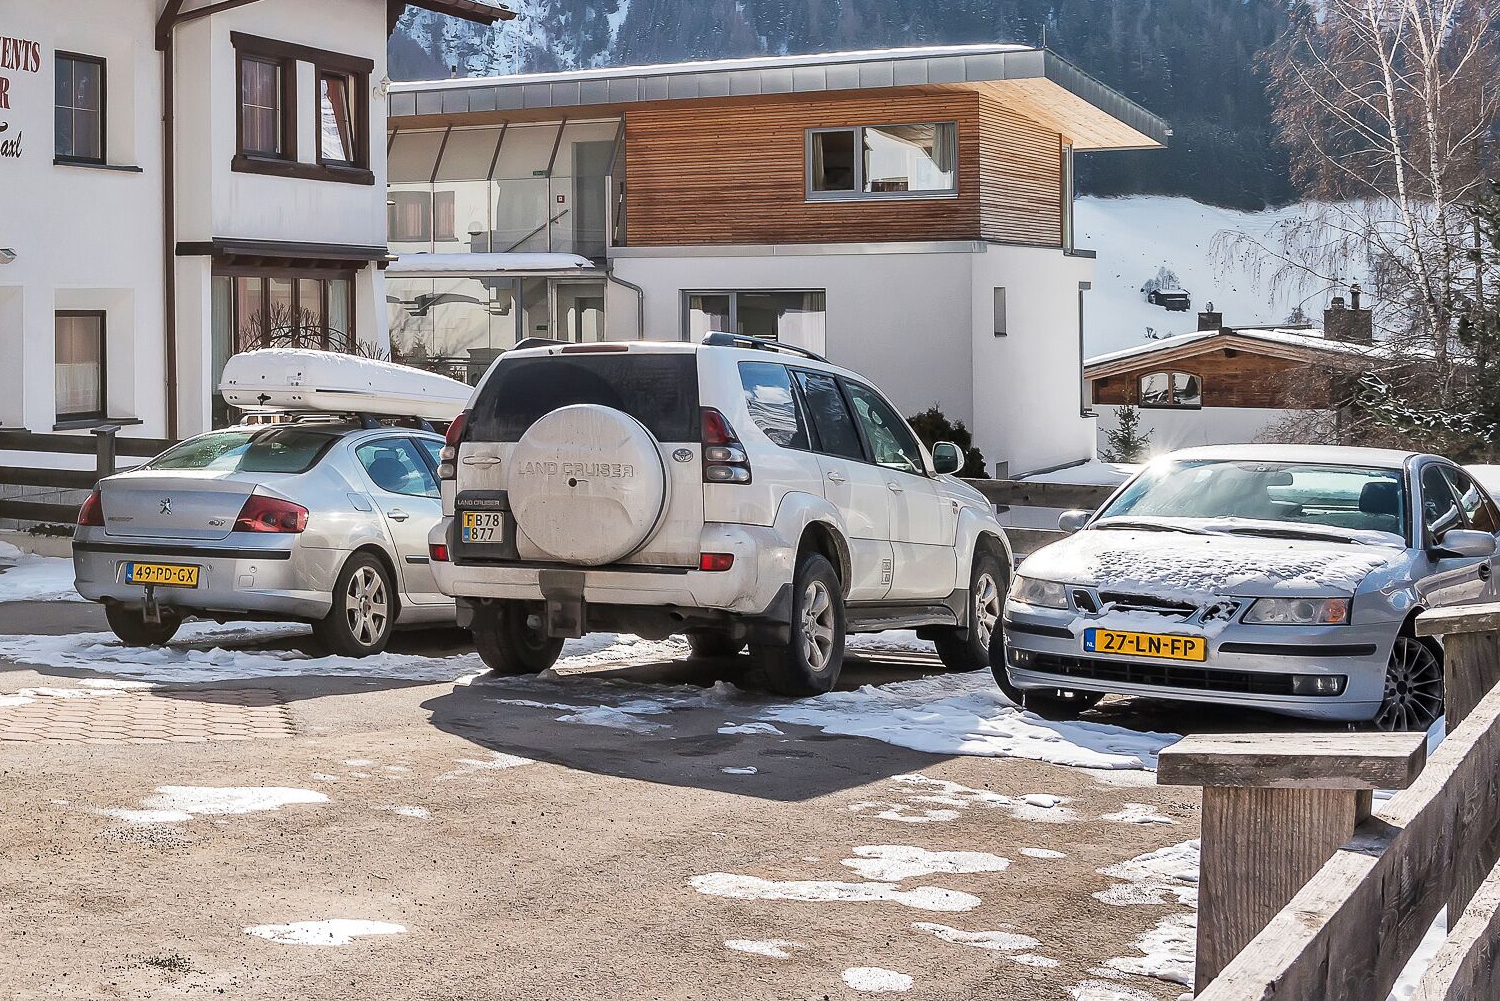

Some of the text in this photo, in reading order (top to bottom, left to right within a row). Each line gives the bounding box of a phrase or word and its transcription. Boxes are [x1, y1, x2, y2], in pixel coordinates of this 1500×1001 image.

[518, 461, 634, 478] LAND CRUISER
[467, 514, 499, 527] FB78
[471, 527, 494, 540] 877
[135, 566, 195, 583] 49-PD-GX
[1103, 633, 1196, 656] 27-LN-FP
